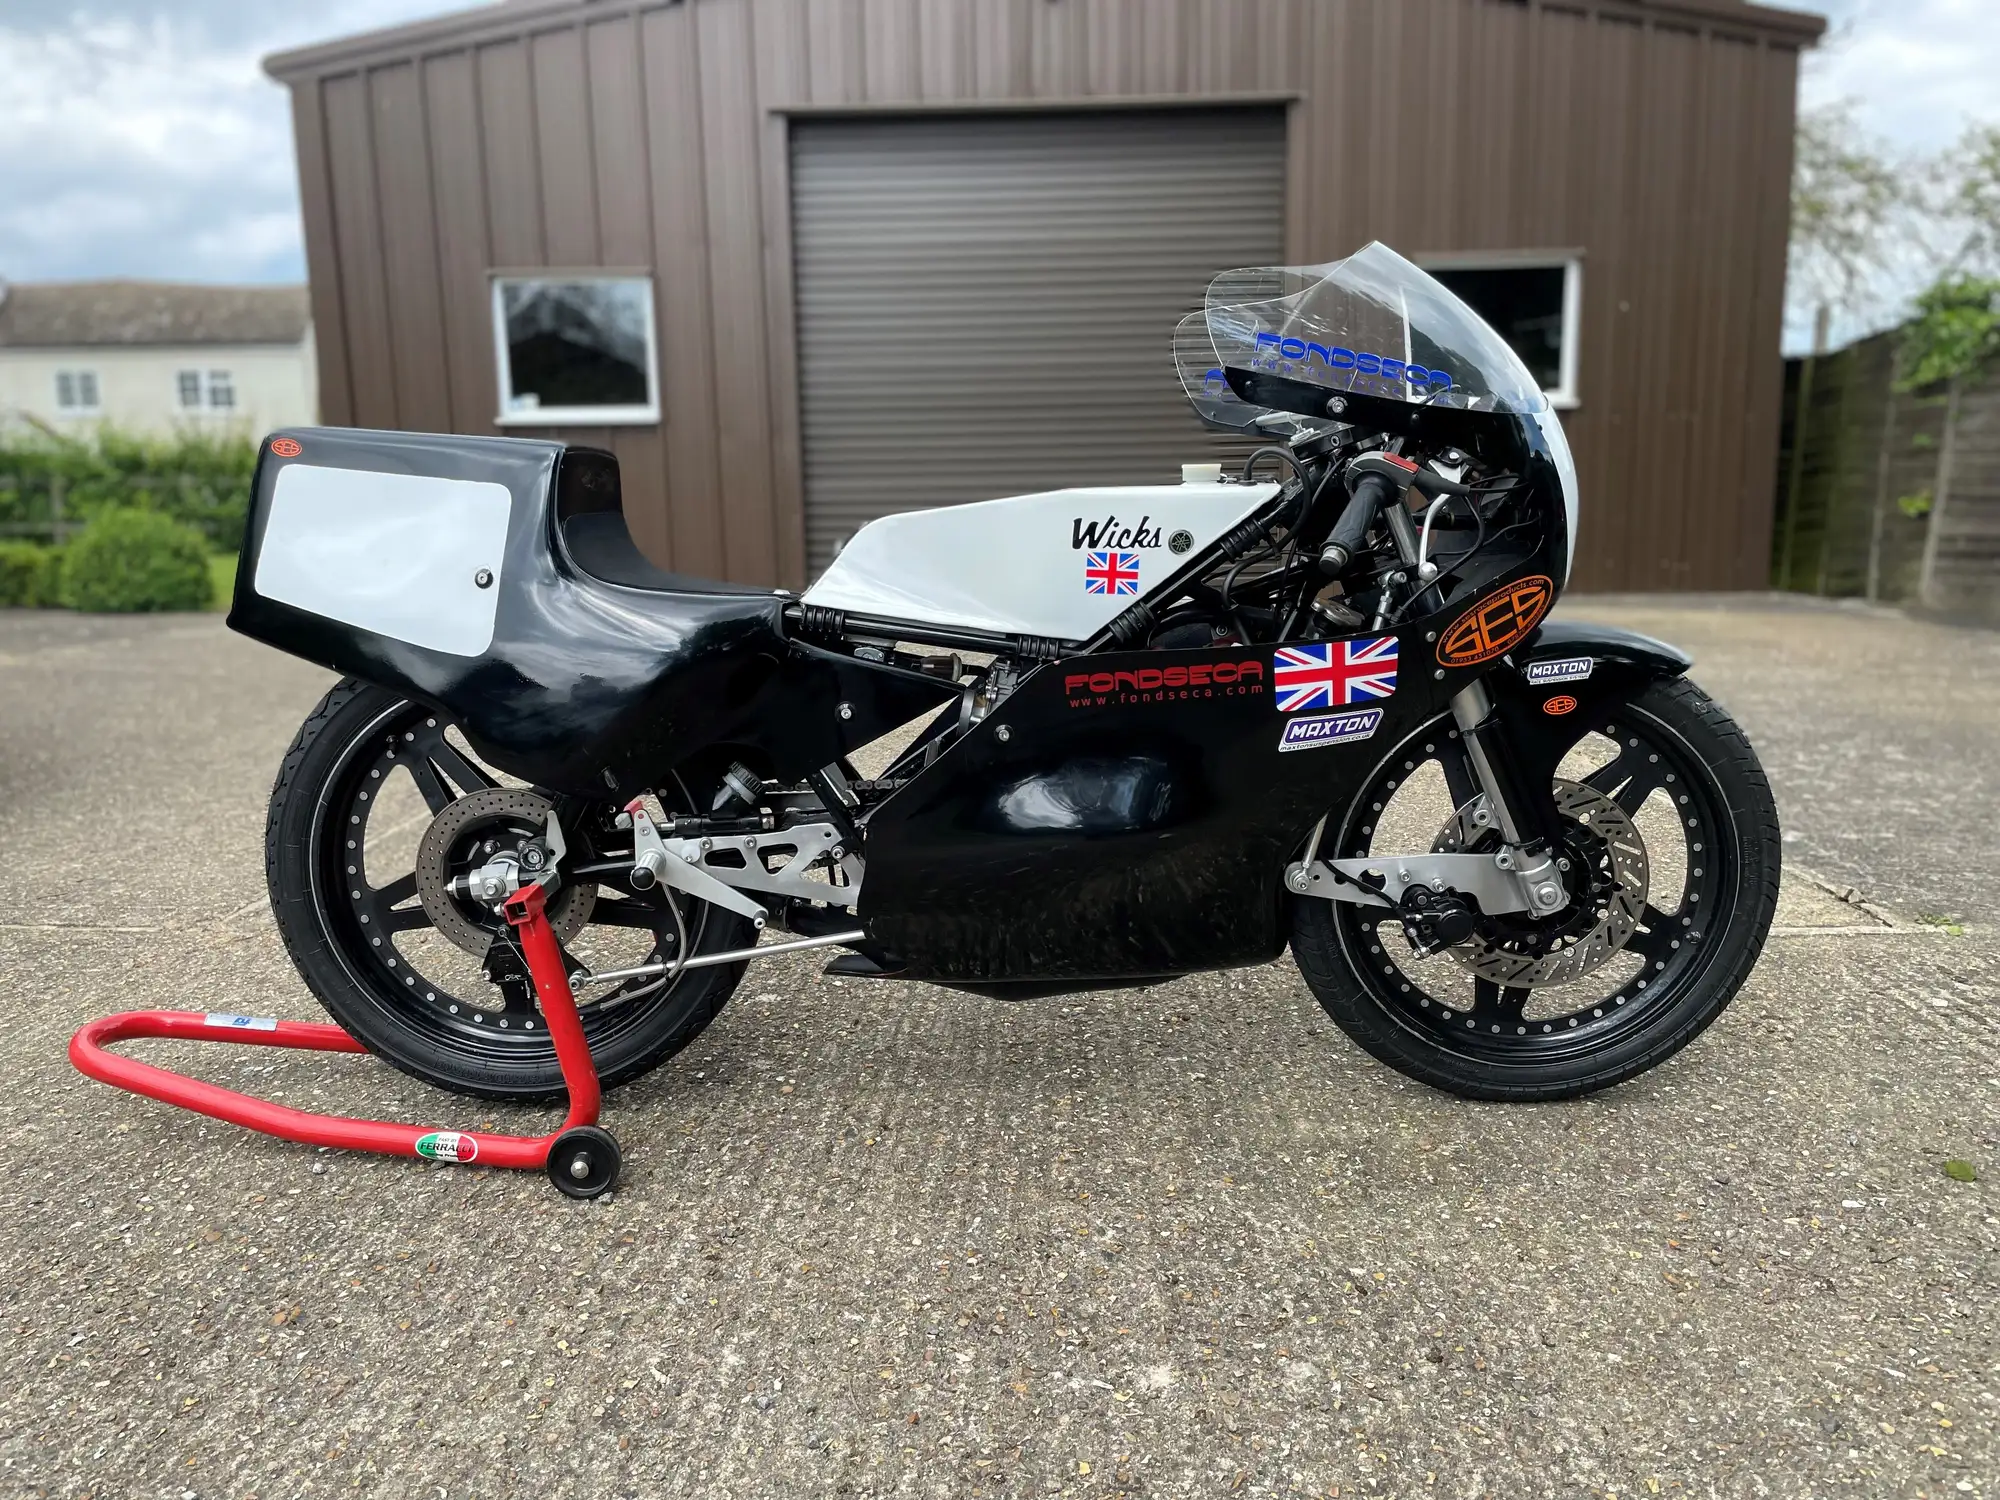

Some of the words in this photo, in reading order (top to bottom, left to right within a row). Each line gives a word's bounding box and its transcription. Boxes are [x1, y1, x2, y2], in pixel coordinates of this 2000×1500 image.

[1254, 332, 1452, 391] FONDSECA
[1072, 515, 1162, 549] Wicks
[1445, 586, 1547, 657] SES
[1065, 661, 1263, 694] FONDSECA
[1532, 661, 1588, 677] MAXTON
[1069, 684, 1263, 708] www.fondseca.com
[1547, 698, 1574, 712] SES
[1289, 714, 1375, 740] MAXTON
